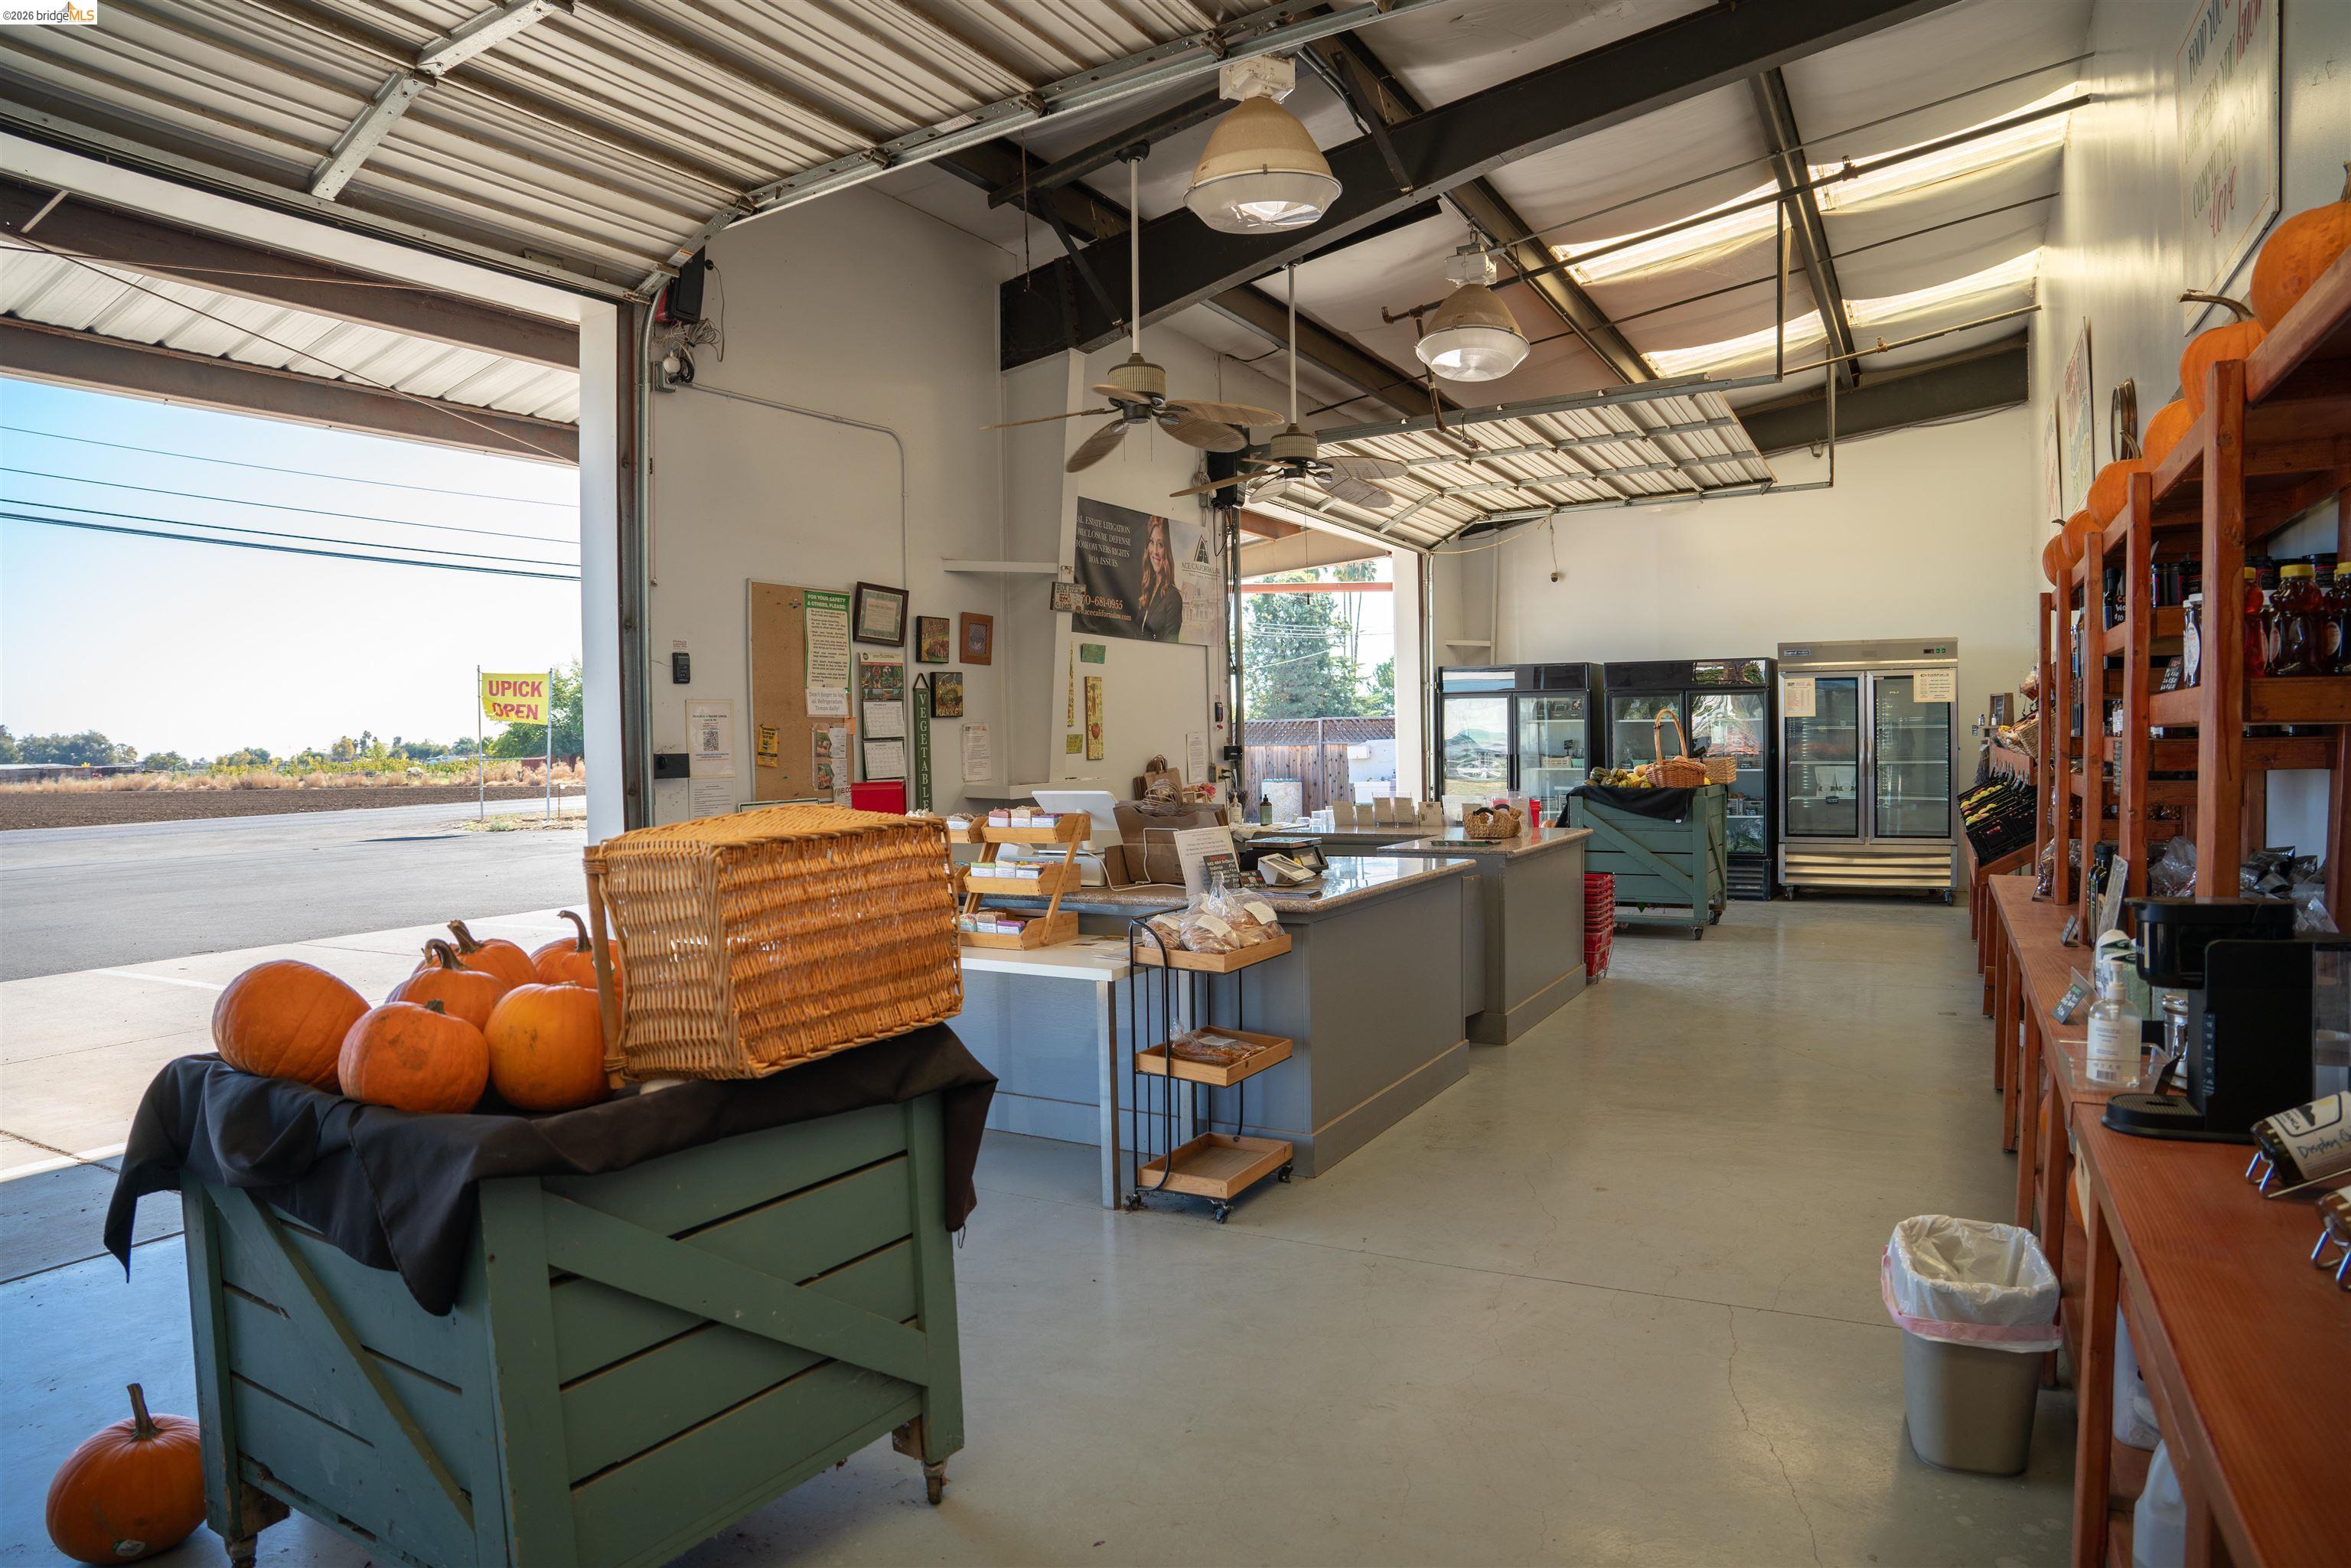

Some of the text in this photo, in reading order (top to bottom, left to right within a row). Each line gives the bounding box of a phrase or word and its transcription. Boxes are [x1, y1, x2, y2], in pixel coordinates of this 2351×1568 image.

[2189, 19, 2206, 85] FOOD
[1085, 517, 1102, 528] ESTATE
[1103, 521, 1130, 533] LITIGATION
[1109, 534, 1131, 546] DEFENSE
[1100, 557, 1118, 567] ISSUES
[488, 680, 543, 698] UPICK
[492, 703, 539, 720] OPEN
[936, 708, 963, 717] MARKET
[2296, 1128, 2351, 1159] Display O
